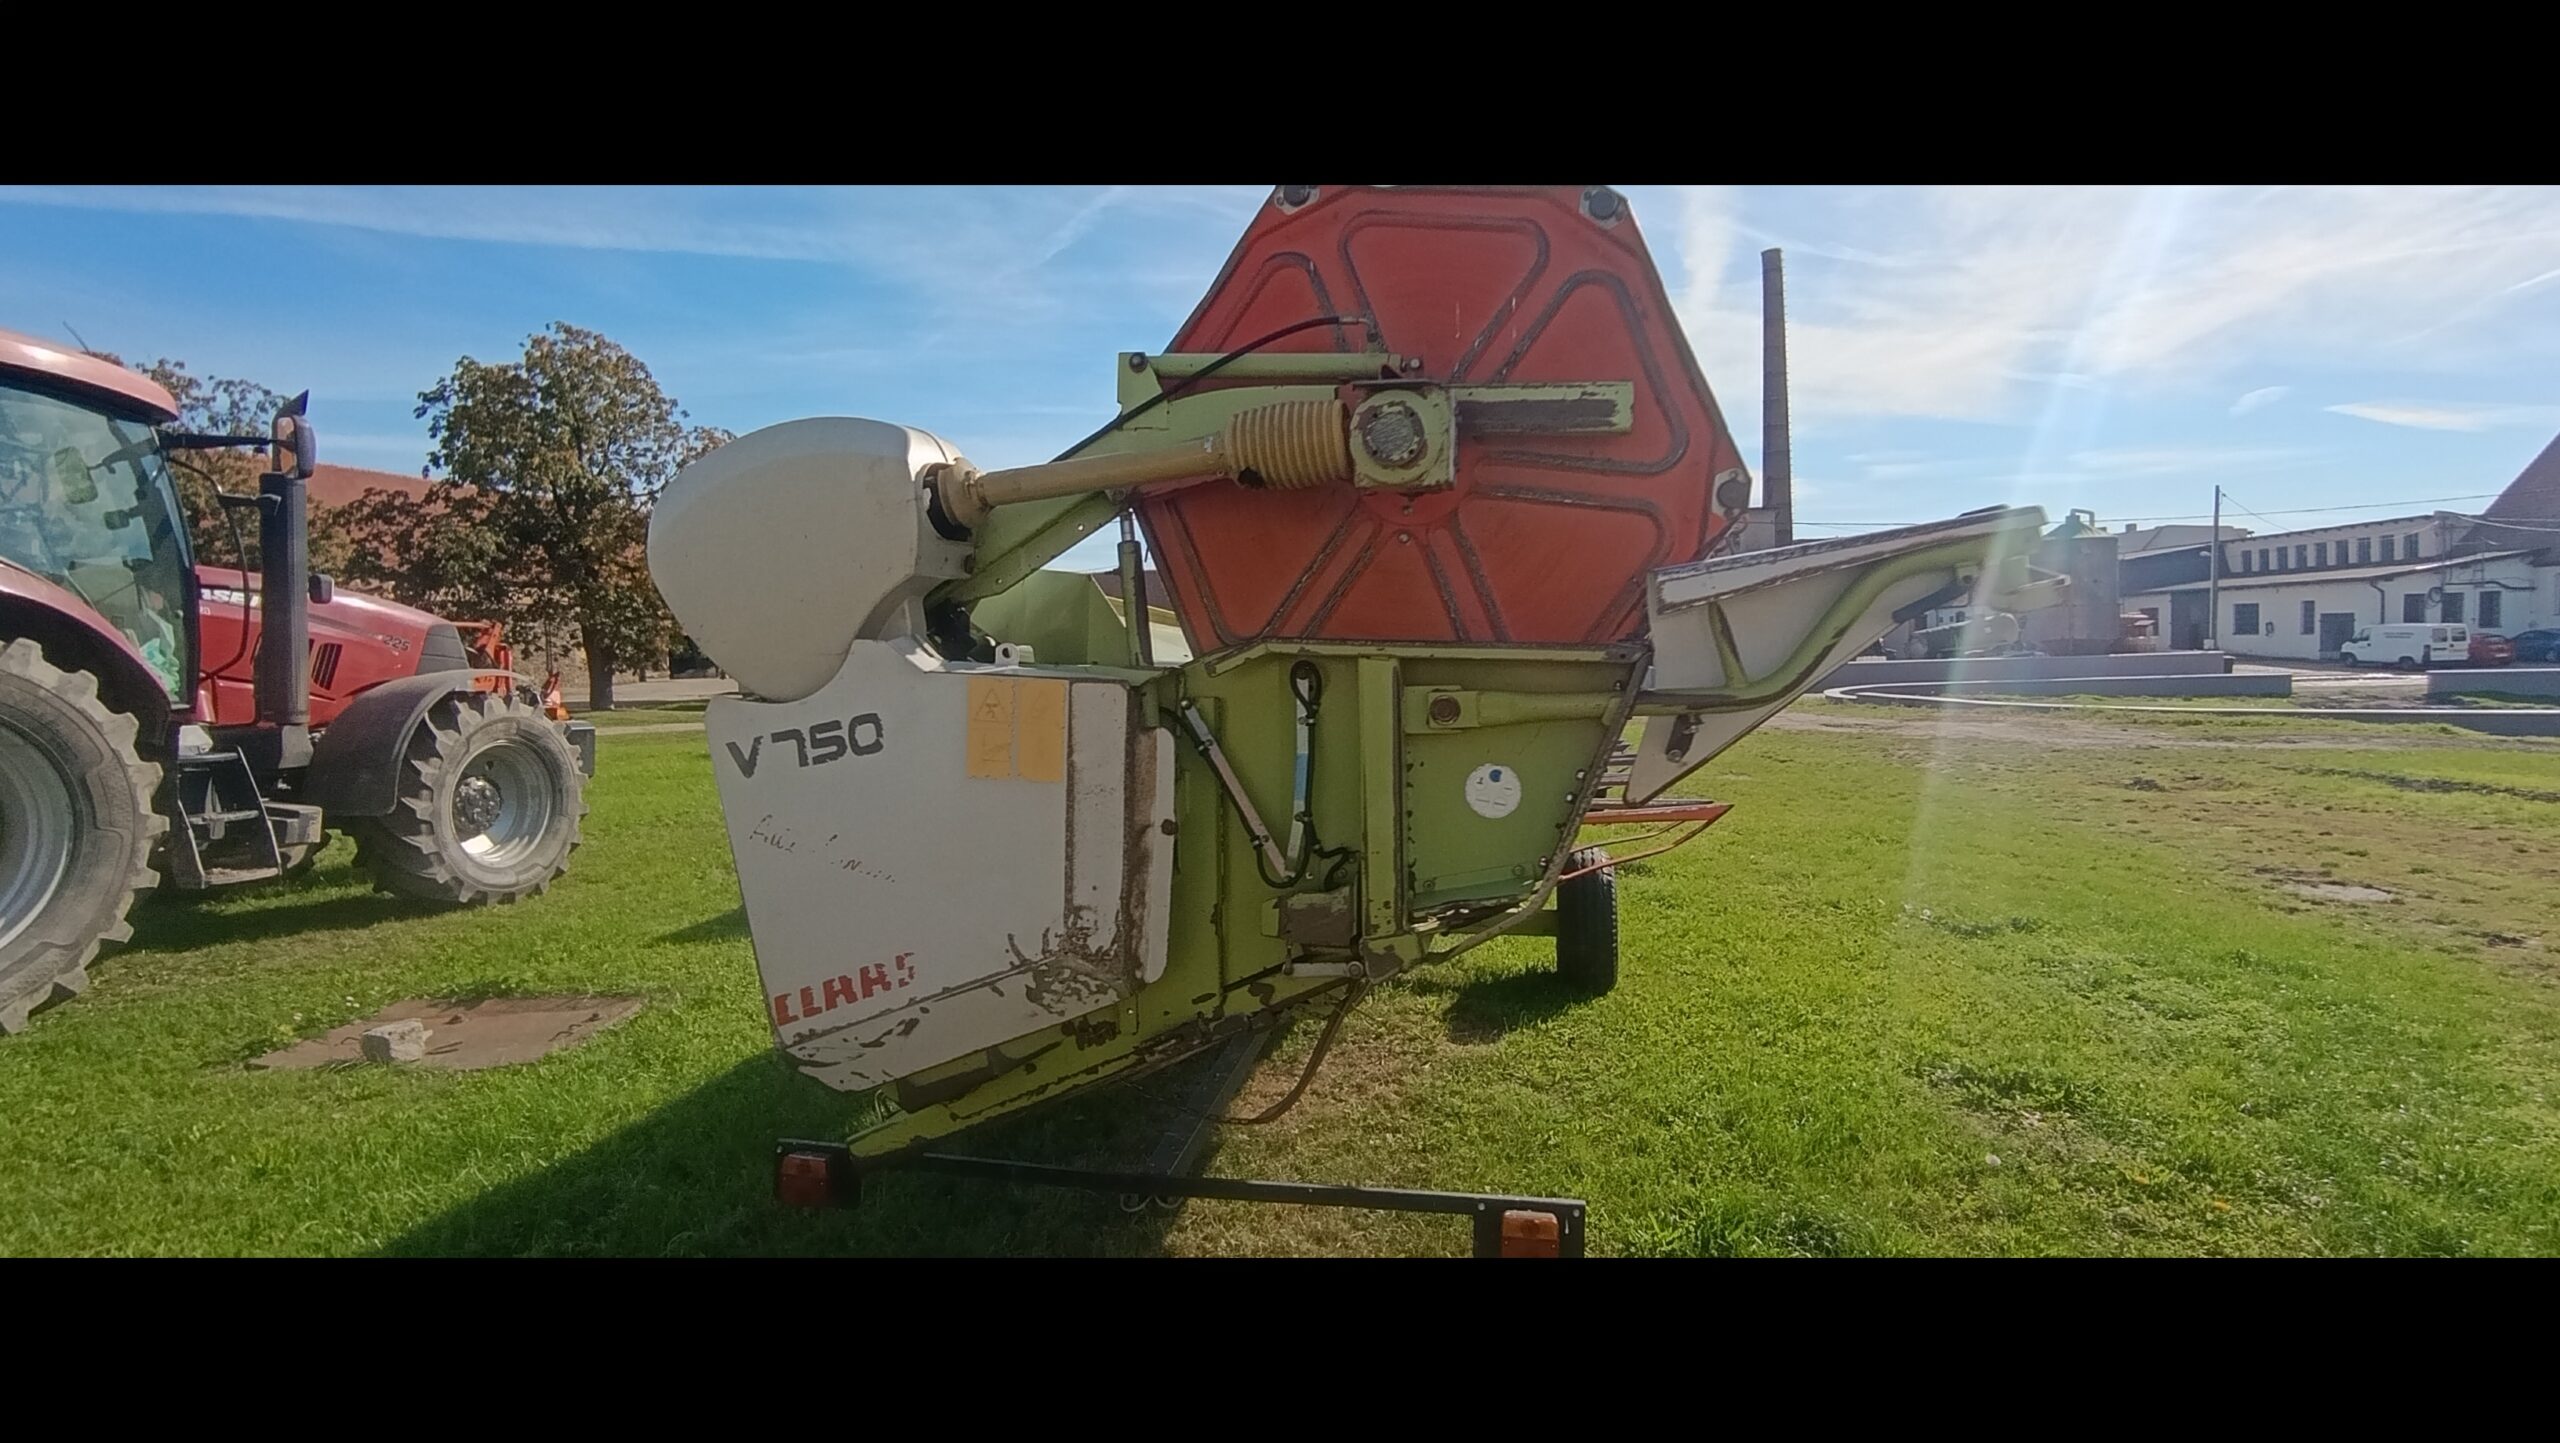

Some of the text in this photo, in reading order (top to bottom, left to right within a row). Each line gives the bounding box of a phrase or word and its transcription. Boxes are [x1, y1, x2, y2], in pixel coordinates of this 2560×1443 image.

[200, 588, 245, 606] ASE
[384, 634, 410, 651] 225
[725, 713, 884, 779] V 750
[774, 952, 915, 1027] CLAAS
